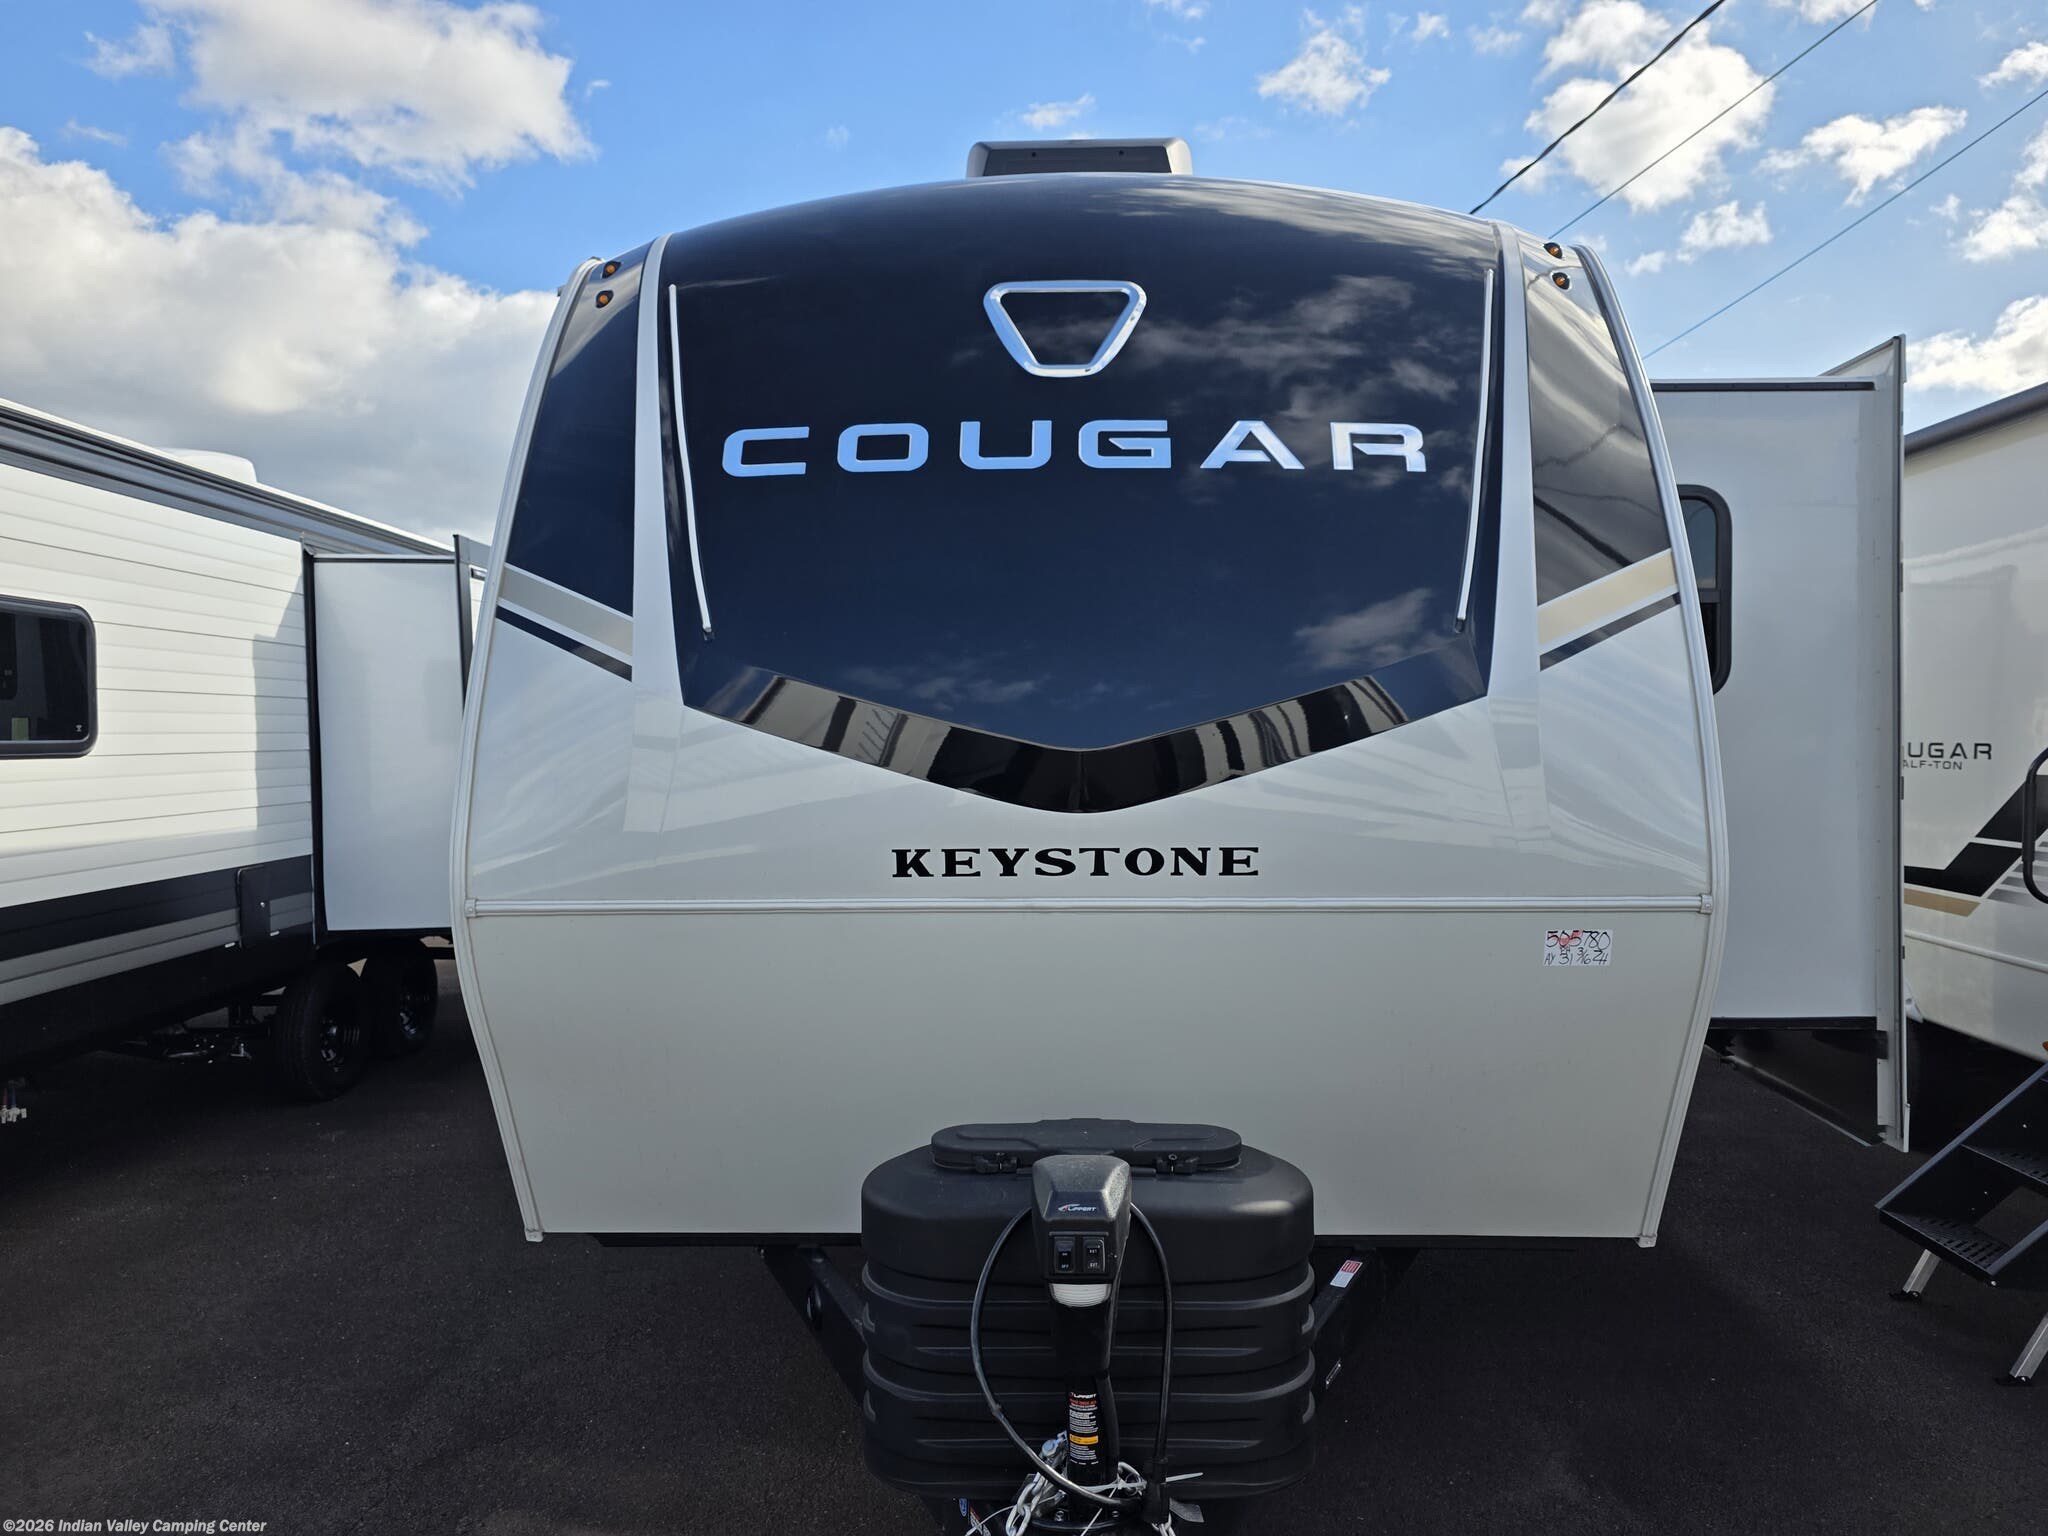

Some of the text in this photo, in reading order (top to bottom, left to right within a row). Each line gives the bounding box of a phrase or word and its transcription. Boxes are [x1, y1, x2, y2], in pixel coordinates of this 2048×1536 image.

[721, 419, 1427, 478] COUGAR
[1901, 742, 1992, 760] UGAR
[1902, 760, 1963, 770] ALF-TON
[891, 847, 1259, 878] KEYSTONE
